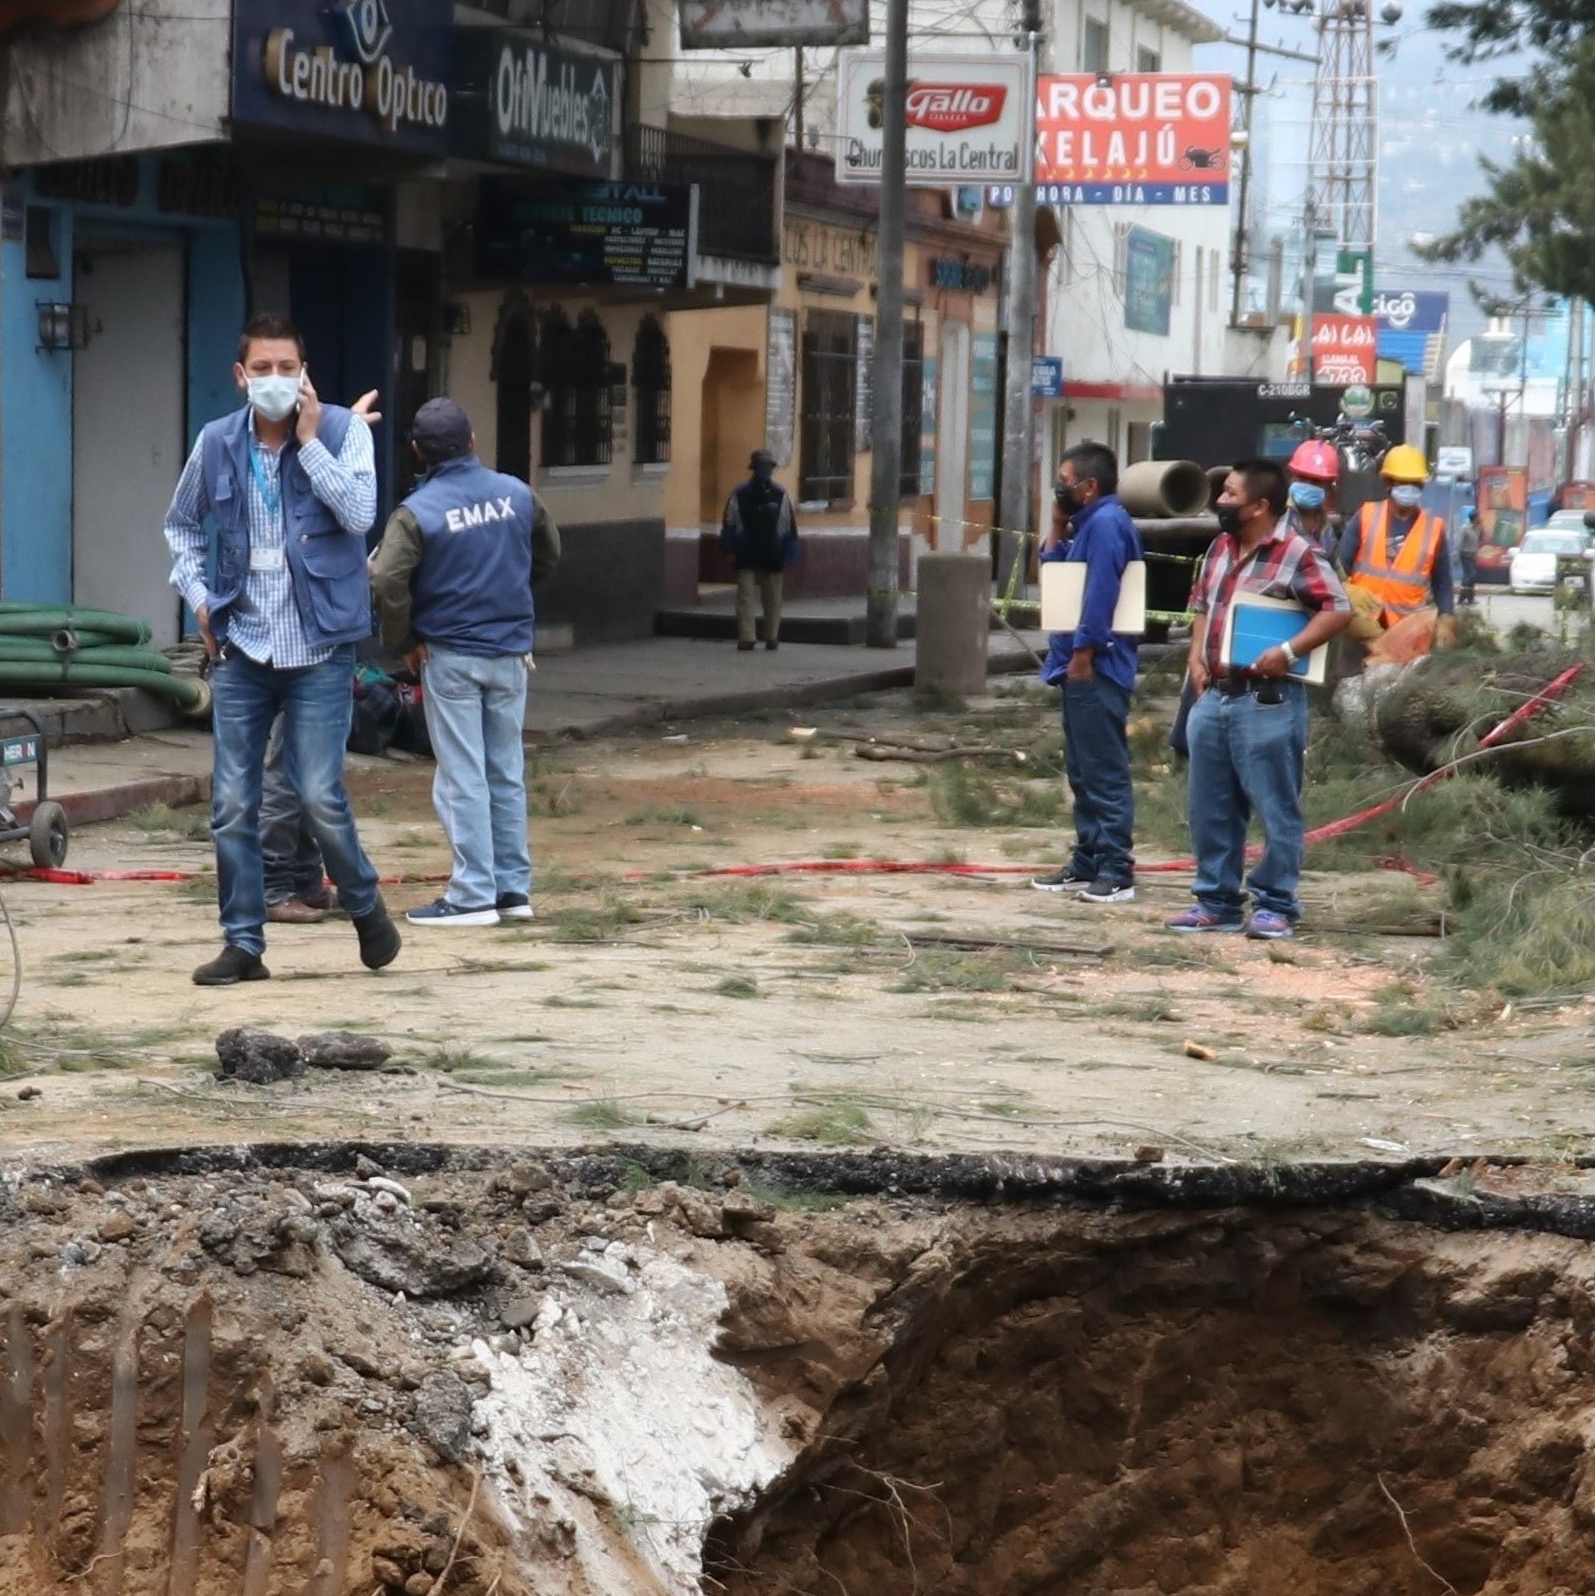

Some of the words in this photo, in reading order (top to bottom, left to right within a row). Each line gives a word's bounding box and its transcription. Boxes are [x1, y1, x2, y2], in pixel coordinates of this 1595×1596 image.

[278, 27, 364, 108] Centro
[377, 54, 447, 132] Optico
[906, 88, 992, 119] Gallo
[849, 138, 936, 169] Churscos
[940, 141, 955, 169] La
[960, 141, 1019, 170] Central
[1036, 186, 1084, 202] HORA
[1113, 183, 1145, 202] DÍA
[1173, 186, 1212, 202] MES
[445, 495, 516, 531] EMAX
